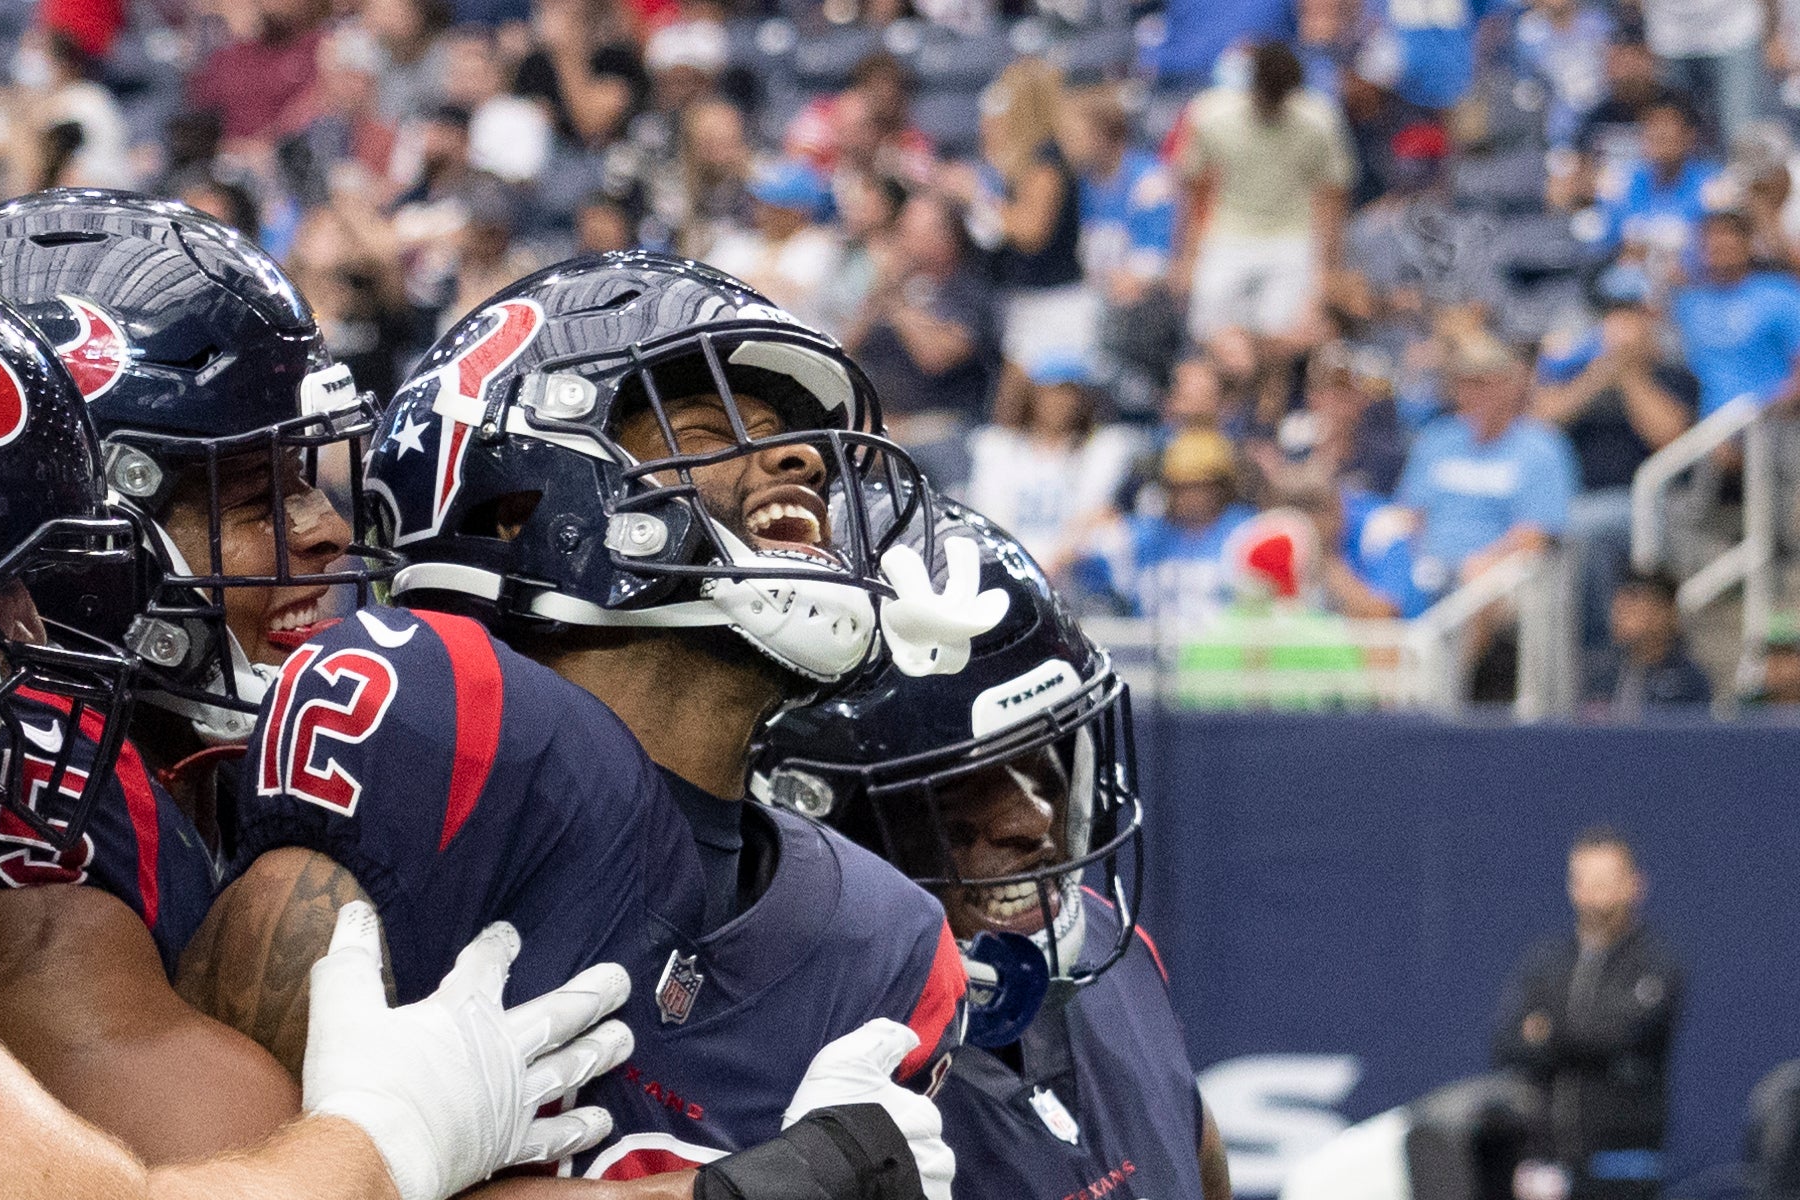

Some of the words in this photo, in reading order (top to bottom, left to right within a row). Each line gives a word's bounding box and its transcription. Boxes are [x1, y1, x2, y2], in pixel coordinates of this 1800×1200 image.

[996, 673, 1064, 709] TEXANS
[257, 643, 398, 817] 12
[662, 980, 688, 1015] NFL
[624, 1064, 704, 1121] XANS
